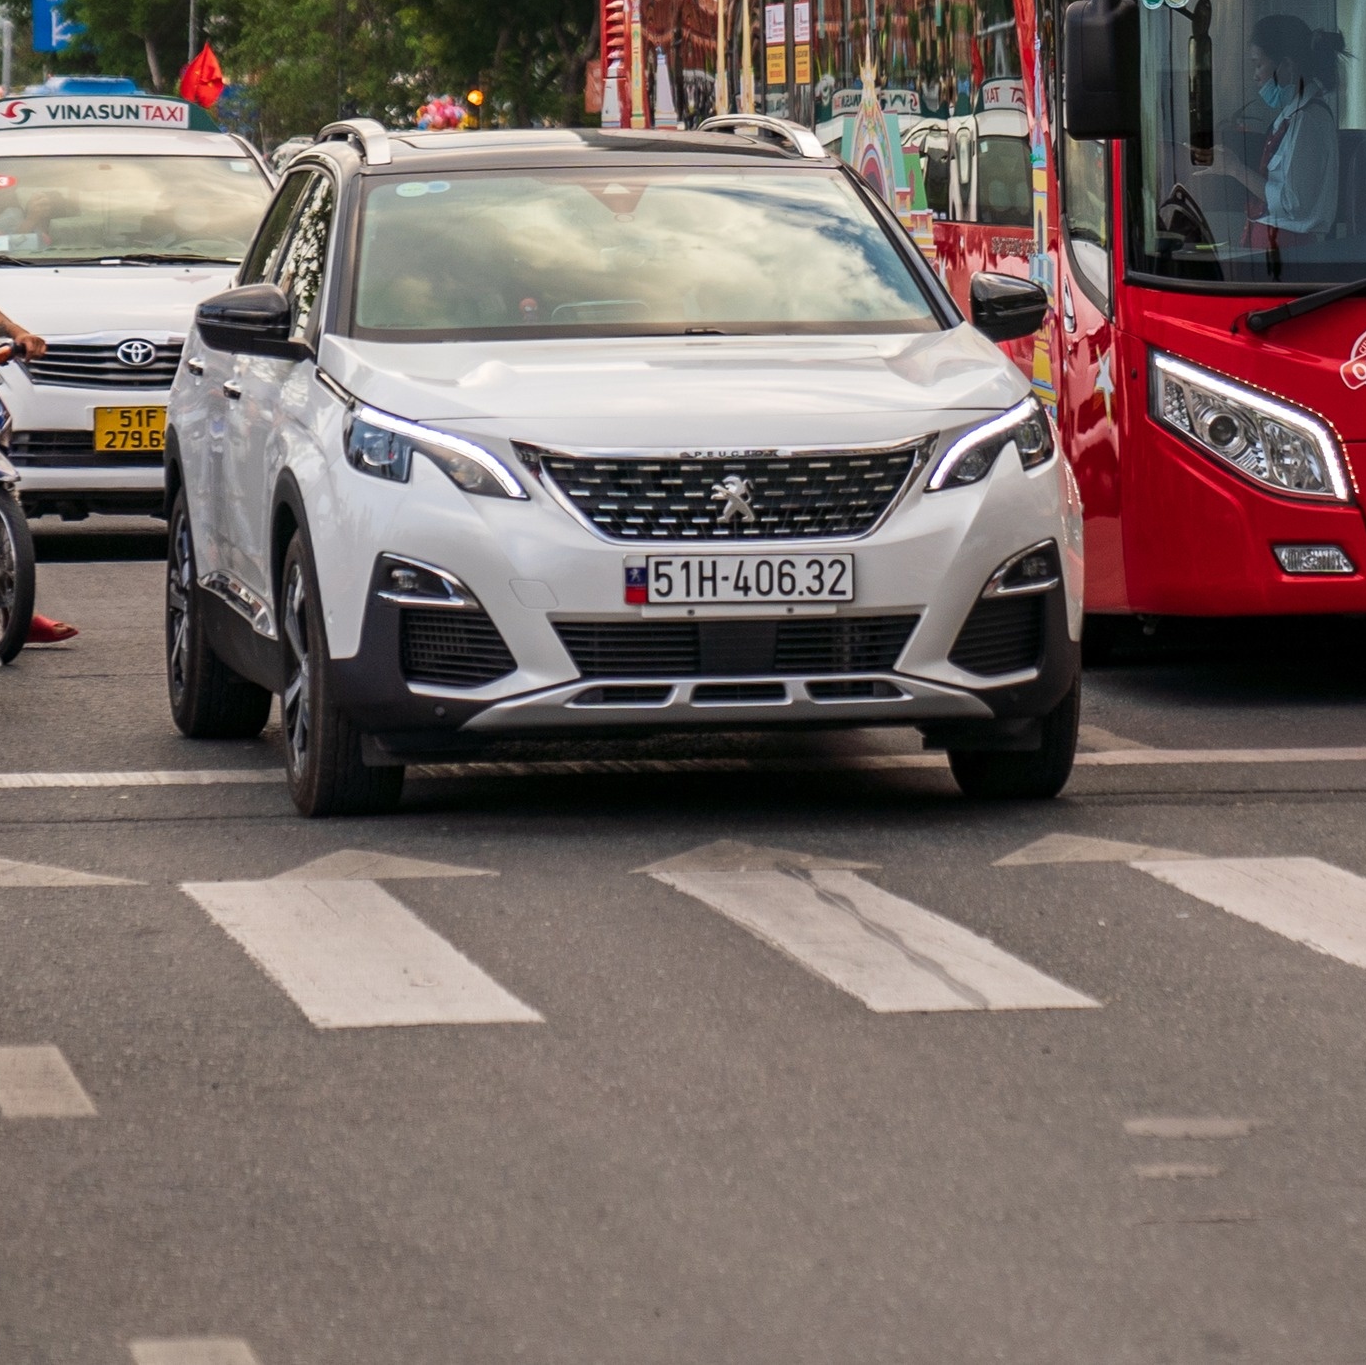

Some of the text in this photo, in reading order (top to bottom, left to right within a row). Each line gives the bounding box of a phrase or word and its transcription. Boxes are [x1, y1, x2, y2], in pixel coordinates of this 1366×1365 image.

[120, 410, 157, 427] 51F
[105, 430, 166, 449] 279.6
[653, 559, 847, 597] 51H-406.32
